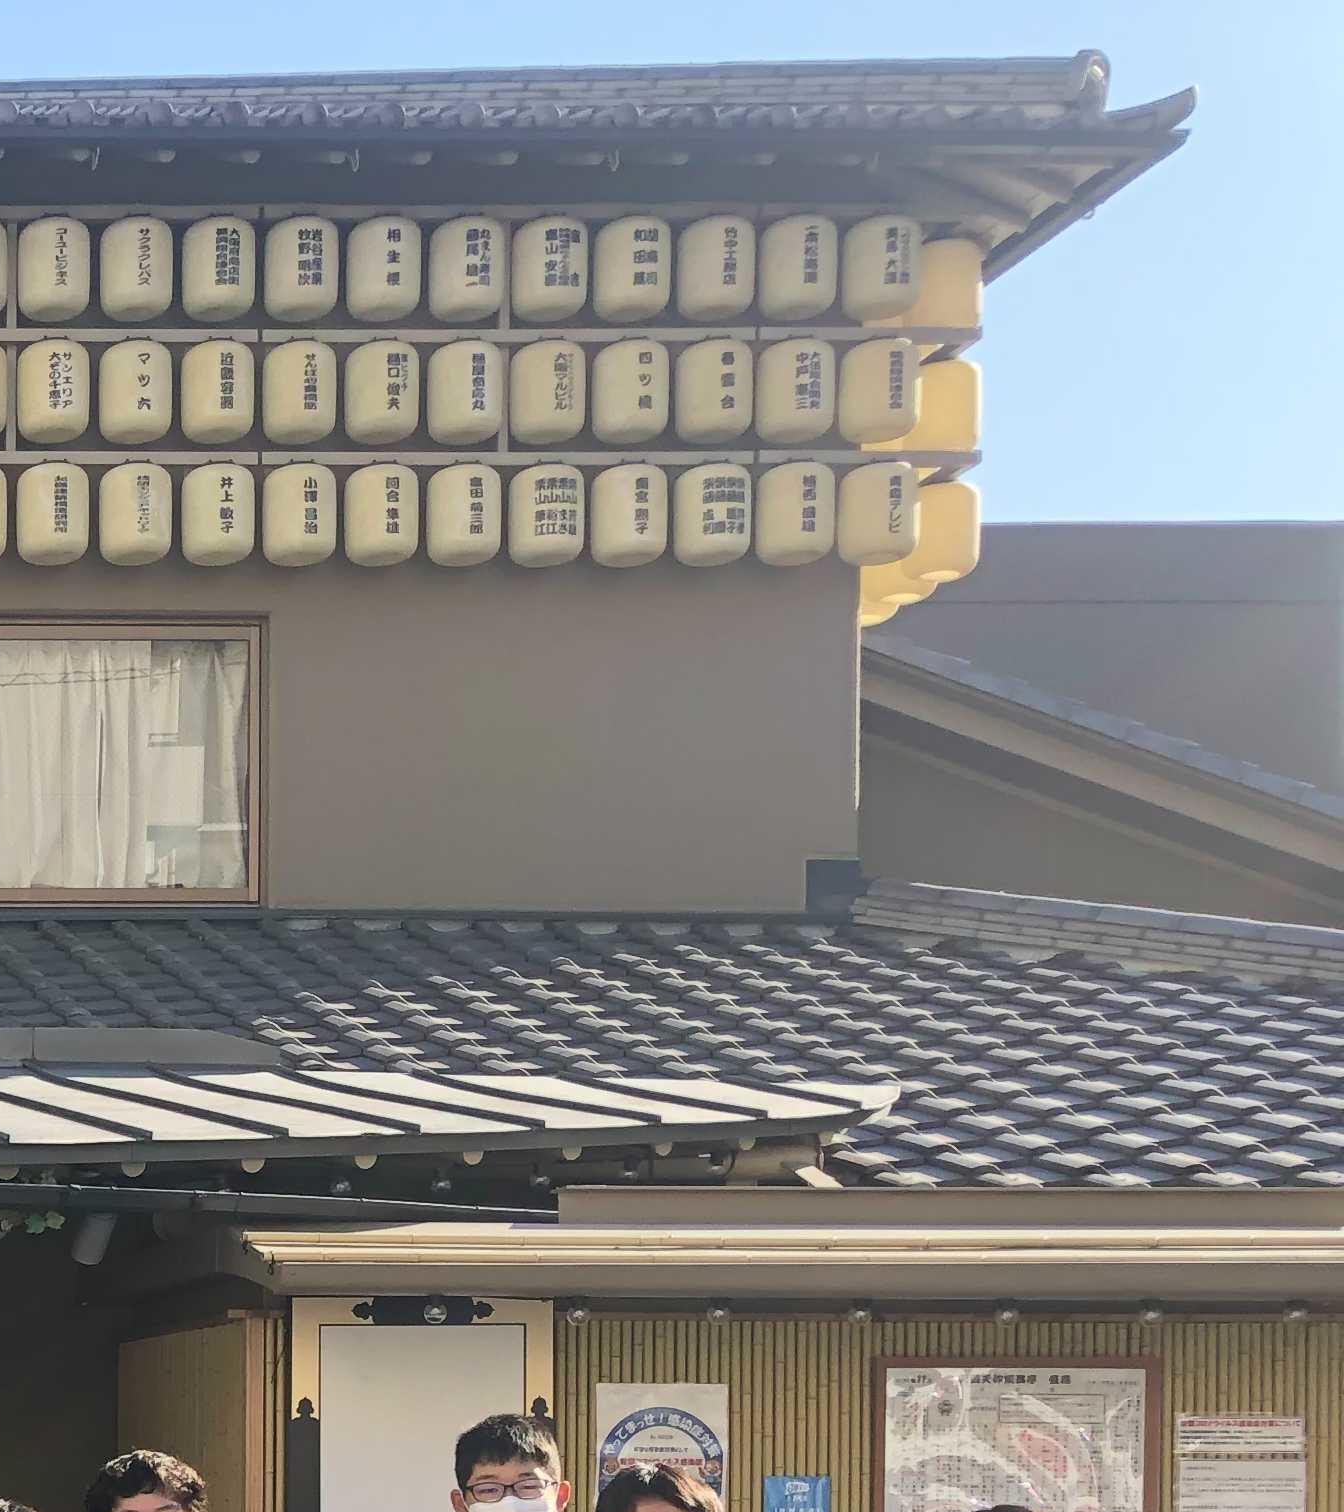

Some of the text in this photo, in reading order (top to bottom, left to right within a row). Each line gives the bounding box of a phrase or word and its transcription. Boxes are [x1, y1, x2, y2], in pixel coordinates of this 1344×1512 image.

[138, 228, 151, 285] サクラクレパス
[723, 227, 737, 285] 竹中工務店
[137, 352, 151, 410] マツ六
